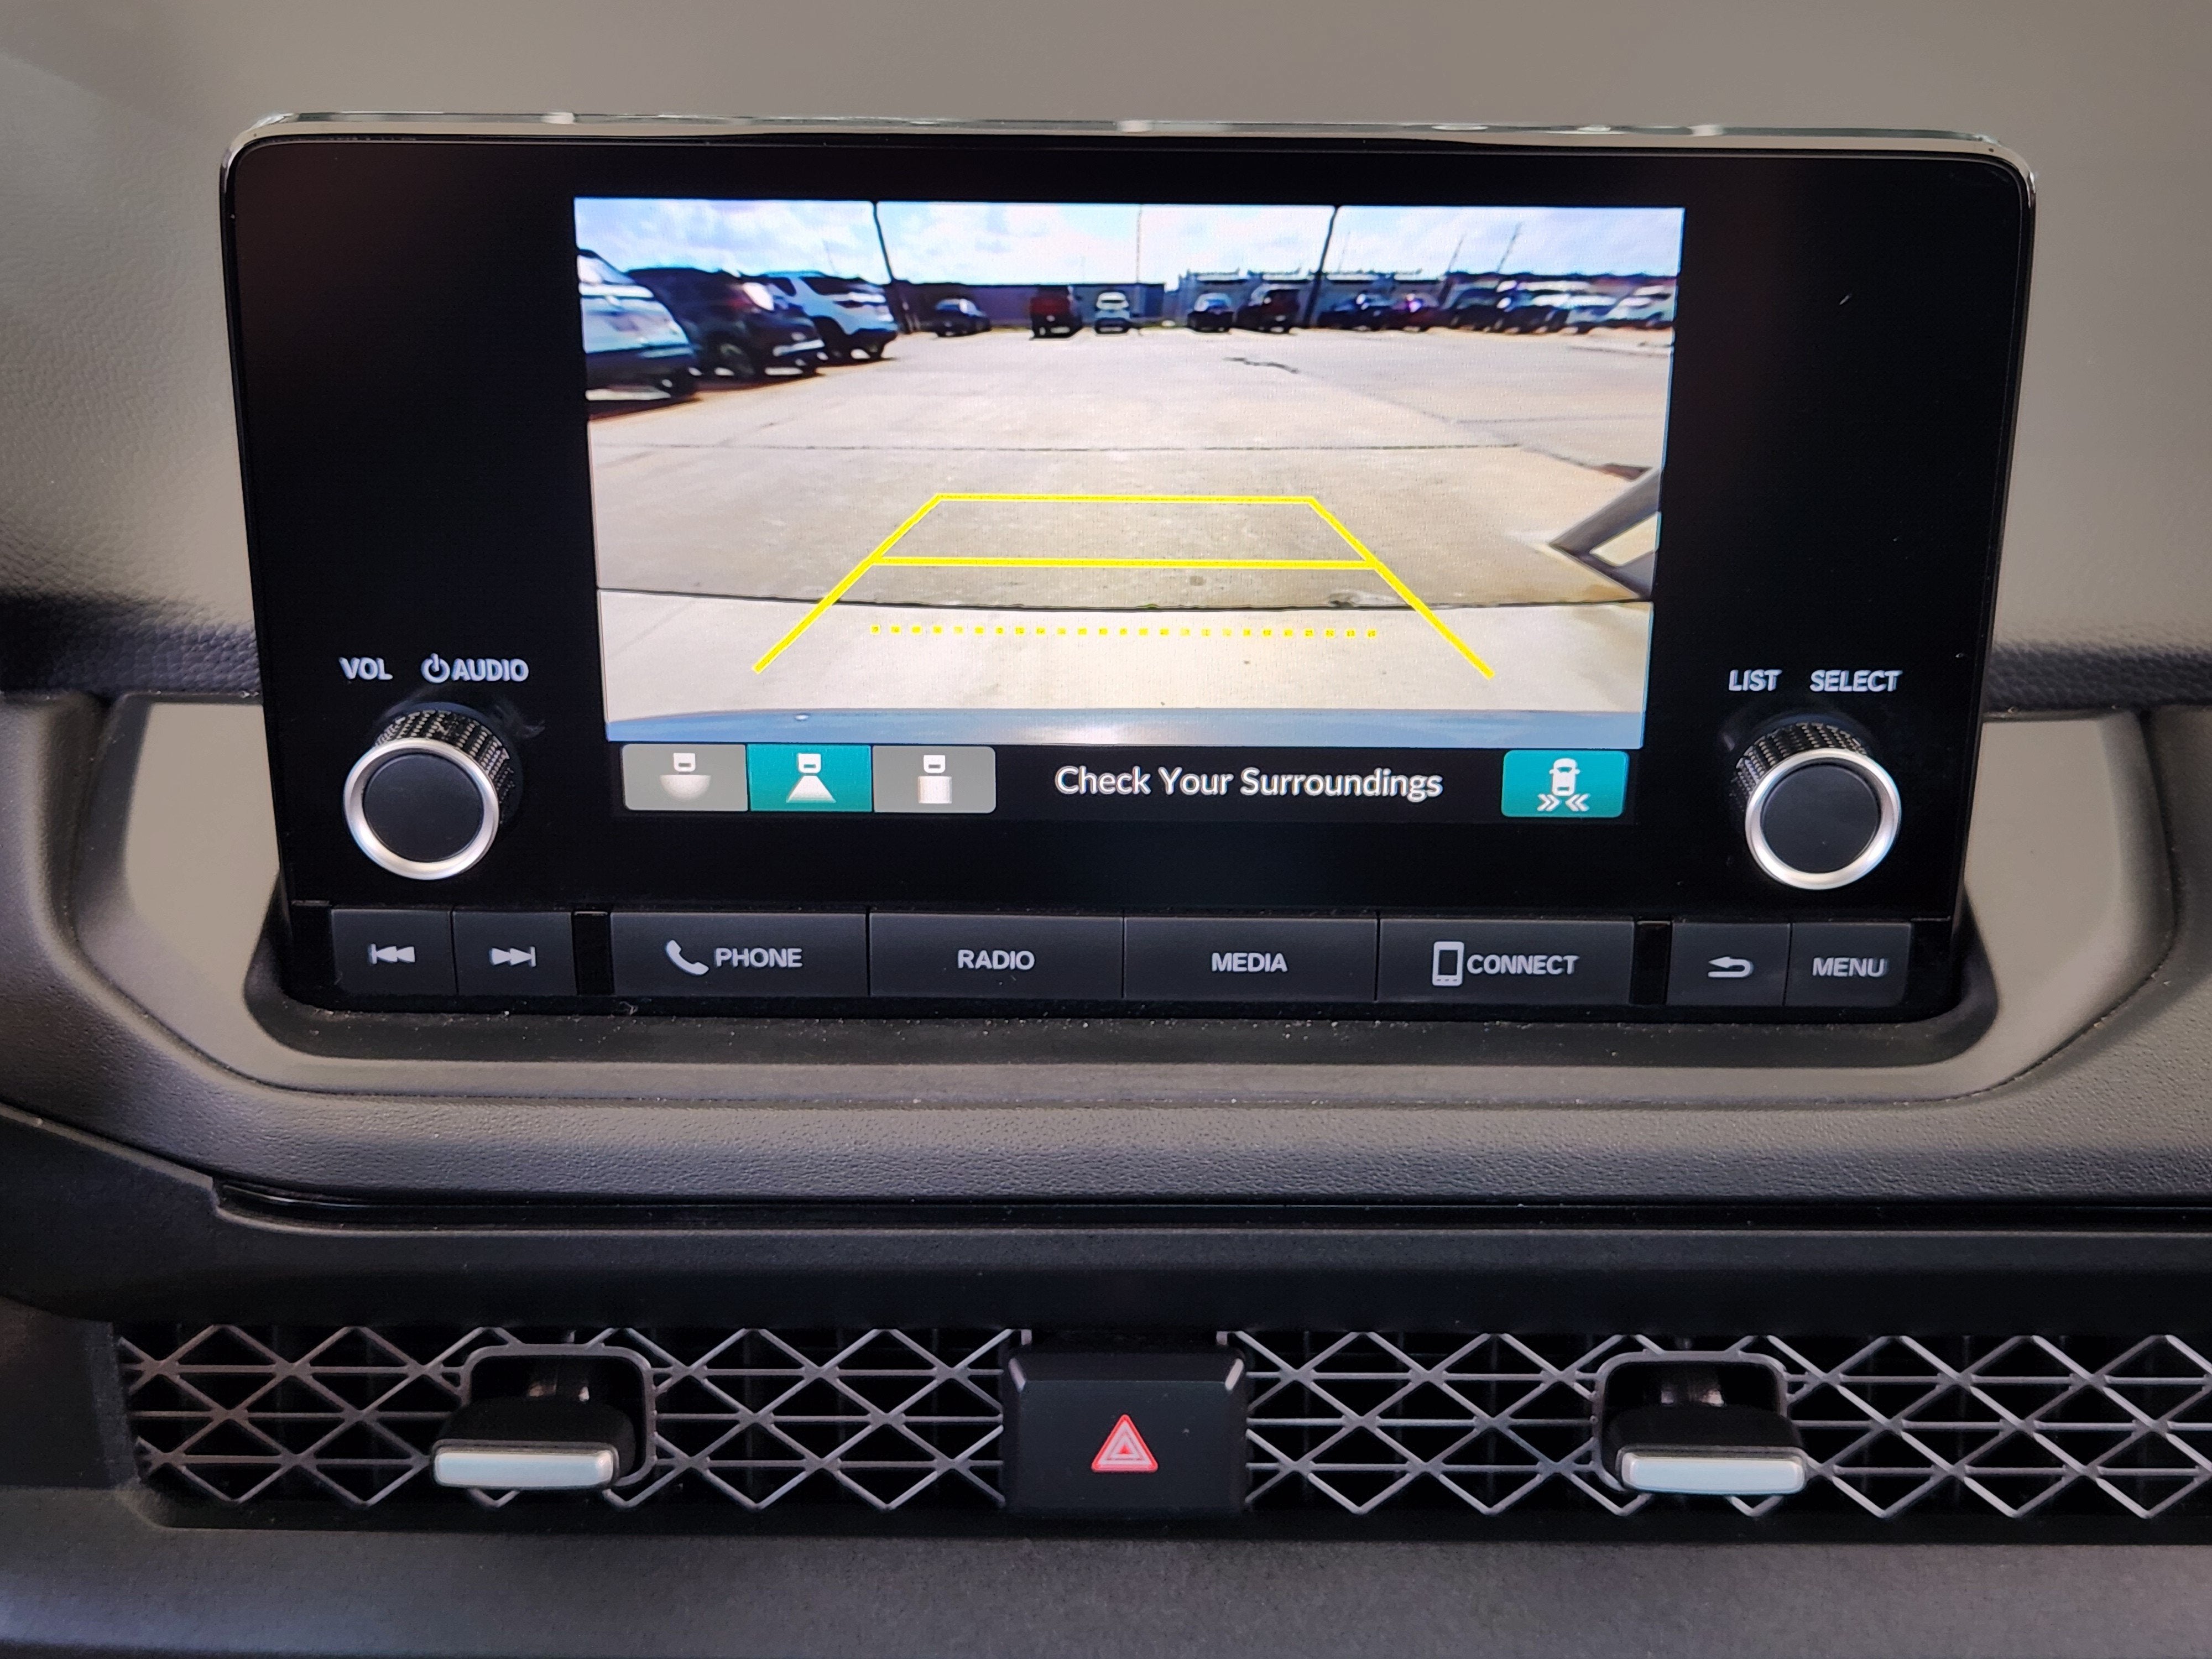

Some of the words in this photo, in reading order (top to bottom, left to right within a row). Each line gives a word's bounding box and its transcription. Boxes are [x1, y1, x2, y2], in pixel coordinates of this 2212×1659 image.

[339, 657, 393, 681] VOL
[452, 658, 529, 682] AUDIO
[1728, 669, 1782, 692] LIST
[1809, 669, 1902, 692] SELECT
[1055, 765, 1150, 795] Check
[1158, 766, 1234, 795] Your
[1240, 766, 1443, 802] Surroundings
[715, 947, 803, 968] PHONE
[958, 950, 1035, 970] RADIO
[1212, 952, 1288, 972] MEDIA
[1467, 954, 1579, 975] CONNECT
[1812, 957, 1886, 977] MENU
